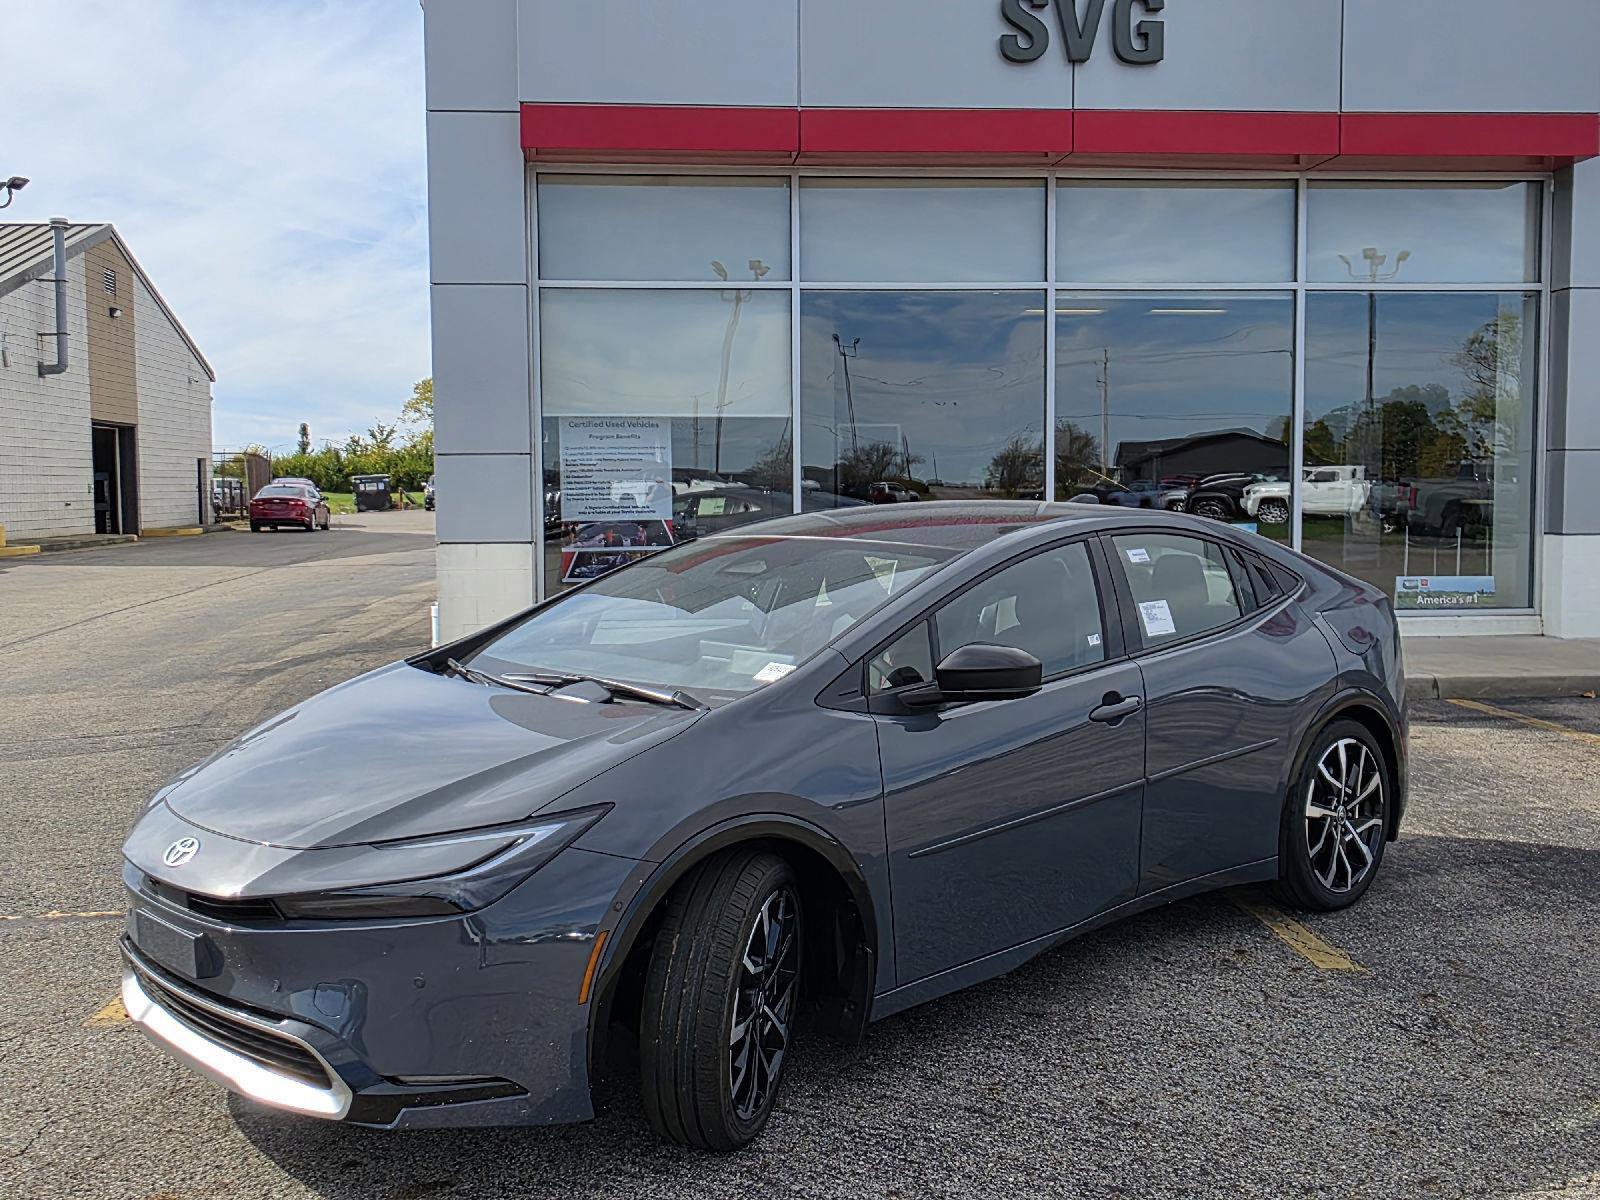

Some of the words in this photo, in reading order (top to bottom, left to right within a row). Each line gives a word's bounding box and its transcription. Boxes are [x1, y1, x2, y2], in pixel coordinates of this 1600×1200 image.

[999, 0, 1165, 65] SVG
[588, 433, 614, 441] Program
[1416, 595, 1464, 605] America's
[1466, 593, 1478, 605] #1
